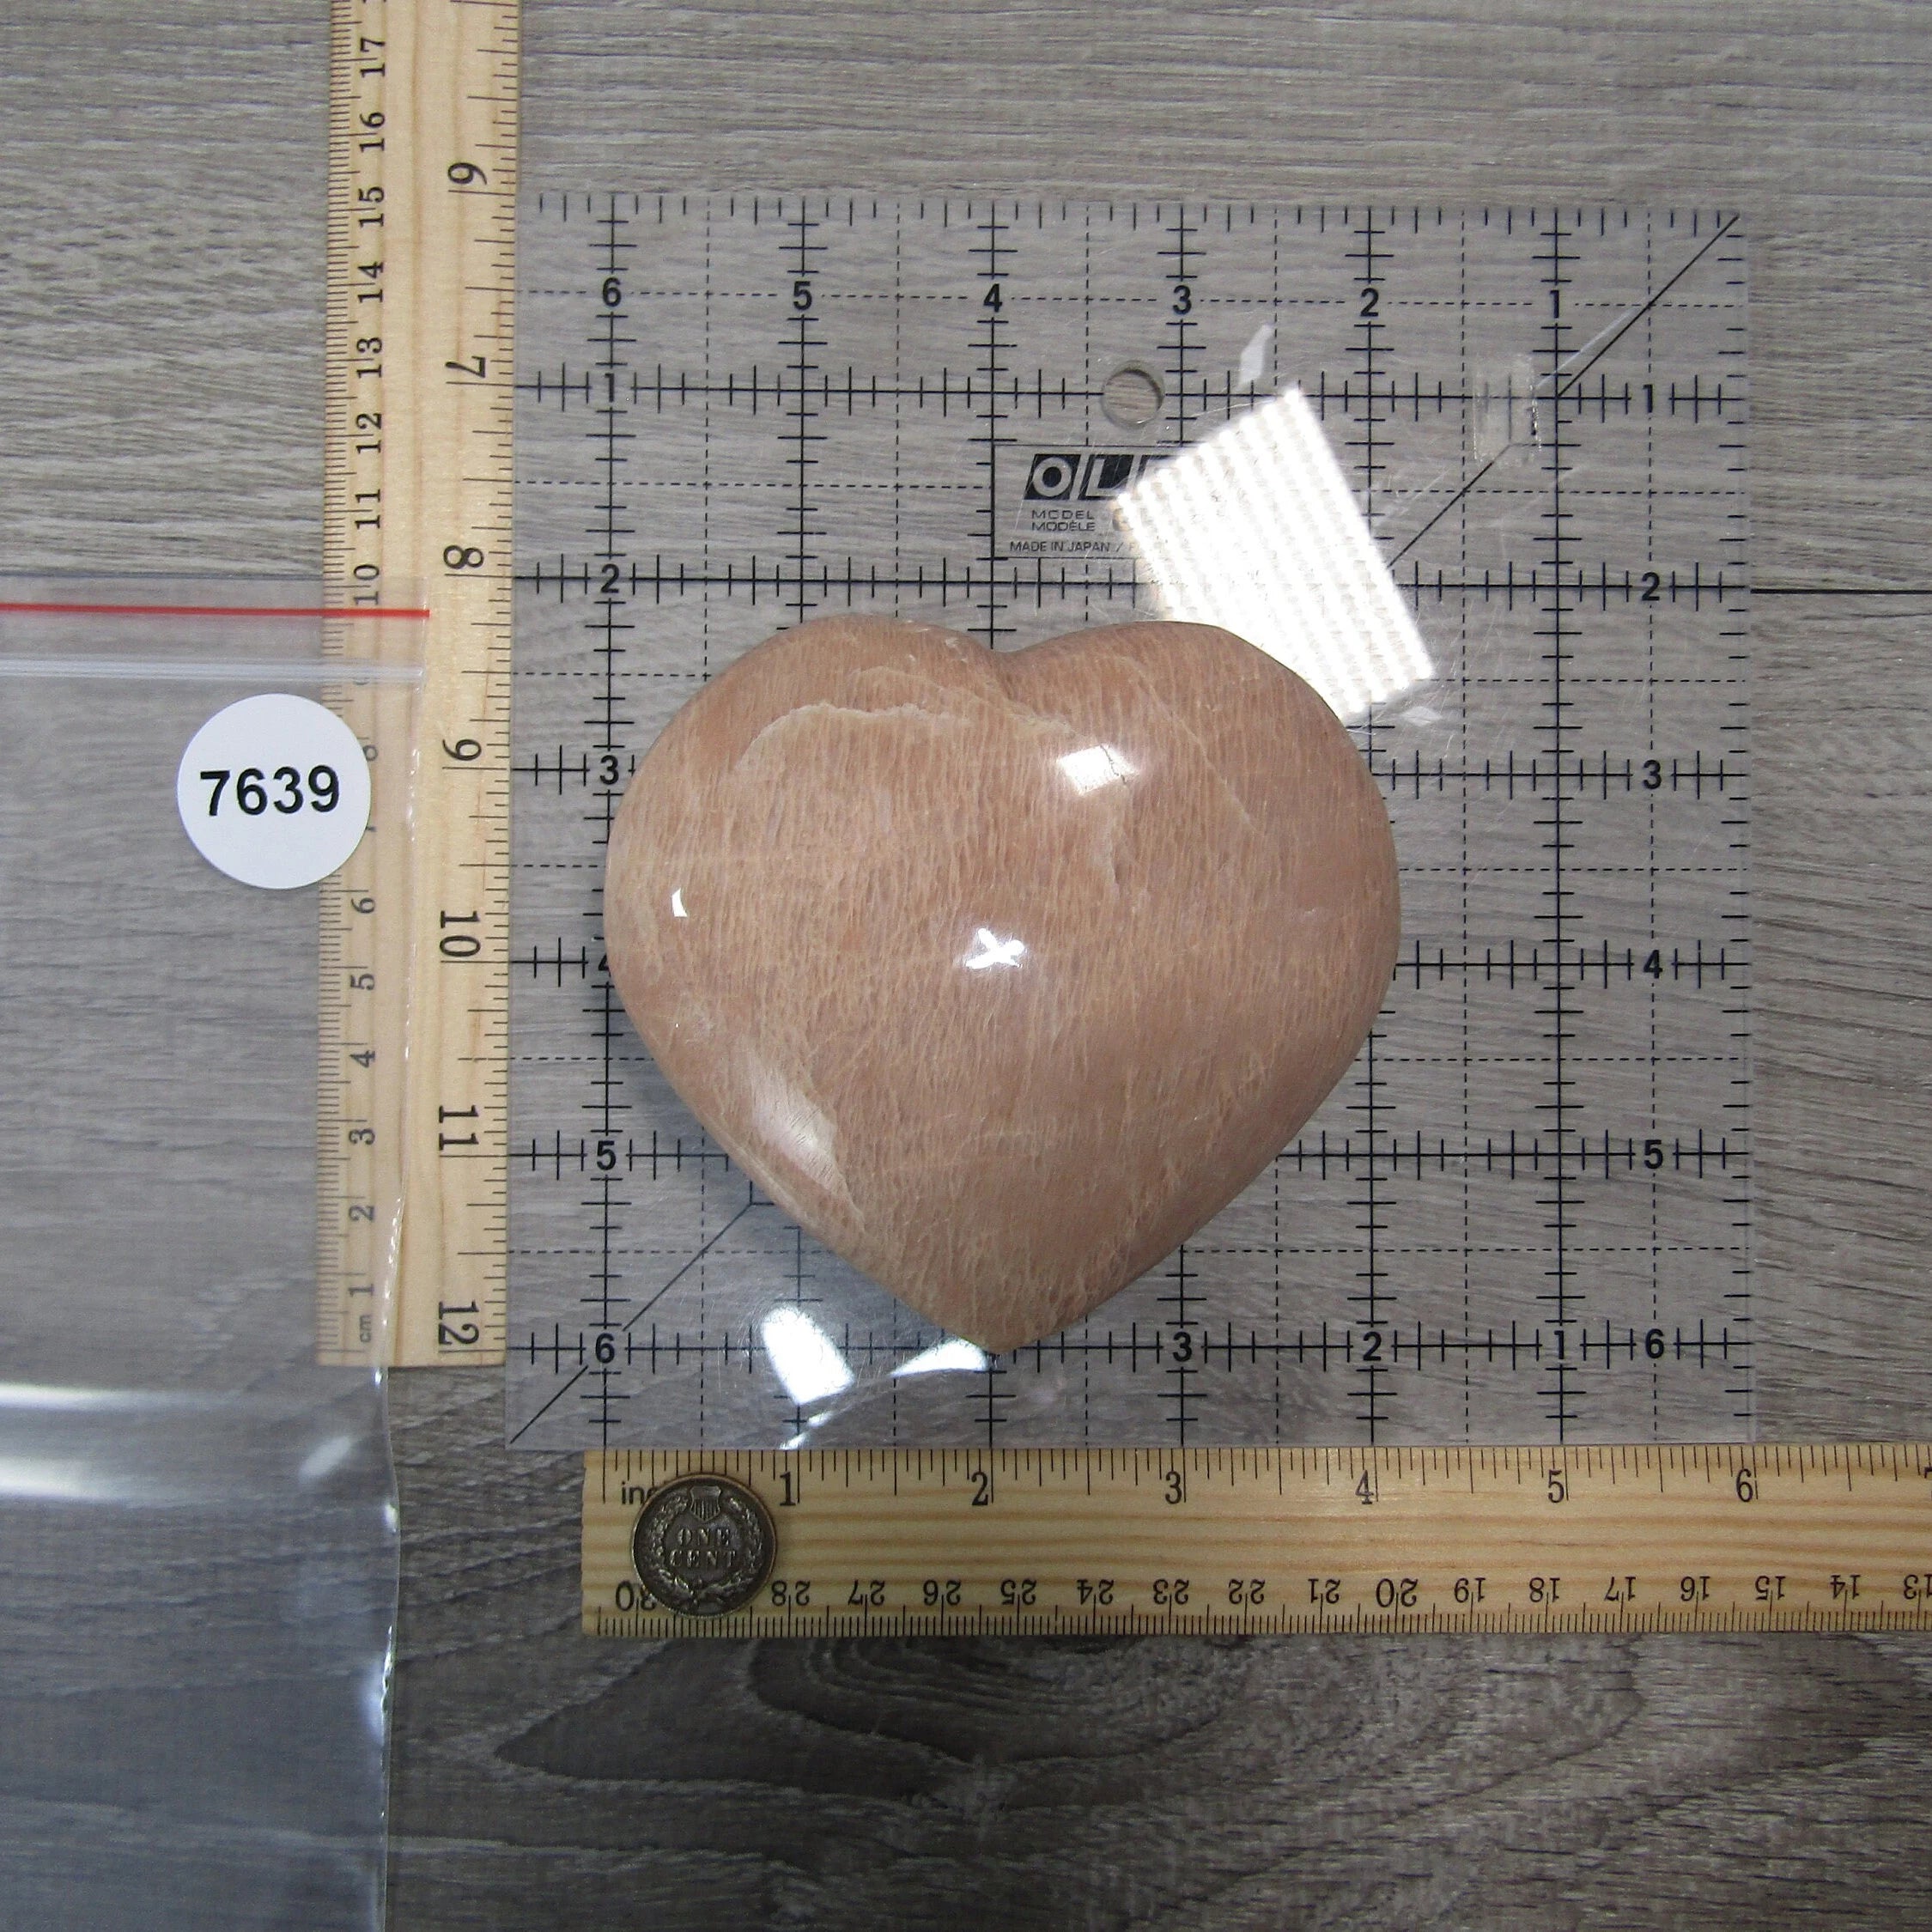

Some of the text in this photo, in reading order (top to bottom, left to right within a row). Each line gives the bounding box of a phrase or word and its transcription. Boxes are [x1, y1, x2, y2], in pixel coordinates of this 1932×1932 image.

[360, 36, 386, 78] 17
[360, 111, 386, 153] 16
[447, 161, 487, 185] 6
[359, 185, 385, 228] 15
[359, 261, 384, 303] 14
[601, 279, 1560, 317] 6 5 4 3 2 1
[356, 337, 383, 378] 13
[445, 355, 486, 379] 7
[605, 374, 616, 401] 1
[1643, 385, 1654, 411] 1
[356, 411, 381, 453] 12
[355, 489, 380, 530] 11
[1032, 509, 1095, 519] MODEL
[443, 544, 484, 569] 8
[1010, 541, 1046, 552] MADE
[1051, 541, 1064, 552] IN
[1067, 541, 1109, 552] JAPAN
[354, 564, 380, 605] 10
[600, 565, 620, 594] 2
[1642, 573, 1661, 601] 2
[442, 738, 482, 762] 9
[598, 755, 618, 786] 3
[1643, 759, 1662, 790] 3
[200, 765, 339, 816] 7639
[440, 909, 481, 957] 10
[1643, 950, 1662, 979] 4
[350, 973, 375, 991] 5
[350, 1050, 376, 1068] 4
[349, 1127, 375, 1145] 3
[438, 1104, 479, 1151] 11
[597, 1141, 616, 1170] 5
[1643, 1139, 1663, 1169] 5
[349, 1205, 374, 1222] 2
[349, 1283, 374, 1296] 1
[359, 1315, 371, 1343] cm
[438, 1300, 479, 1346] 12
[595, 1329, 1664, 1363] 6 3 2 1 6
[780, 1472, 796, 1505] 1
[971, 1471, 988, 1505] 2
[1165, 1471, 1182, 1504] 3
[1355, 1470, 1373, 1504] 4
[1548, 1469, 1564, 1504] 5
[1735, 1468, 1753, 1503] 6
[677, 1528, 731, 1546] ONE
[670, 1549, 737, 1567] CENT
[772, 1580, 811, 1605] 28
[848, 1580, 885, 1605] 27
[923, 1580, 961, 1605] 26
[1000, 1579, 1036, 1605] 25
[1077, 1579, 1114, 1605] 24
[1153, 1578, 1189, 1604] 23
[1228, 1578, 1265, 1604] 22
[1308, 1578, 1340, 1604] 21
[1376, 1578, 1418, 1607] 20
[1454, 1577, 1485, 1602] 19
[1529, 1577, 1560, 1602] 18
[1605, 1577, 1636, 1601] 17
[1680, 1576, 1710, 1601] 16
[1755, 1576, 1786, 1601] 15
[1831, 1575, 1861, 1600] 14
